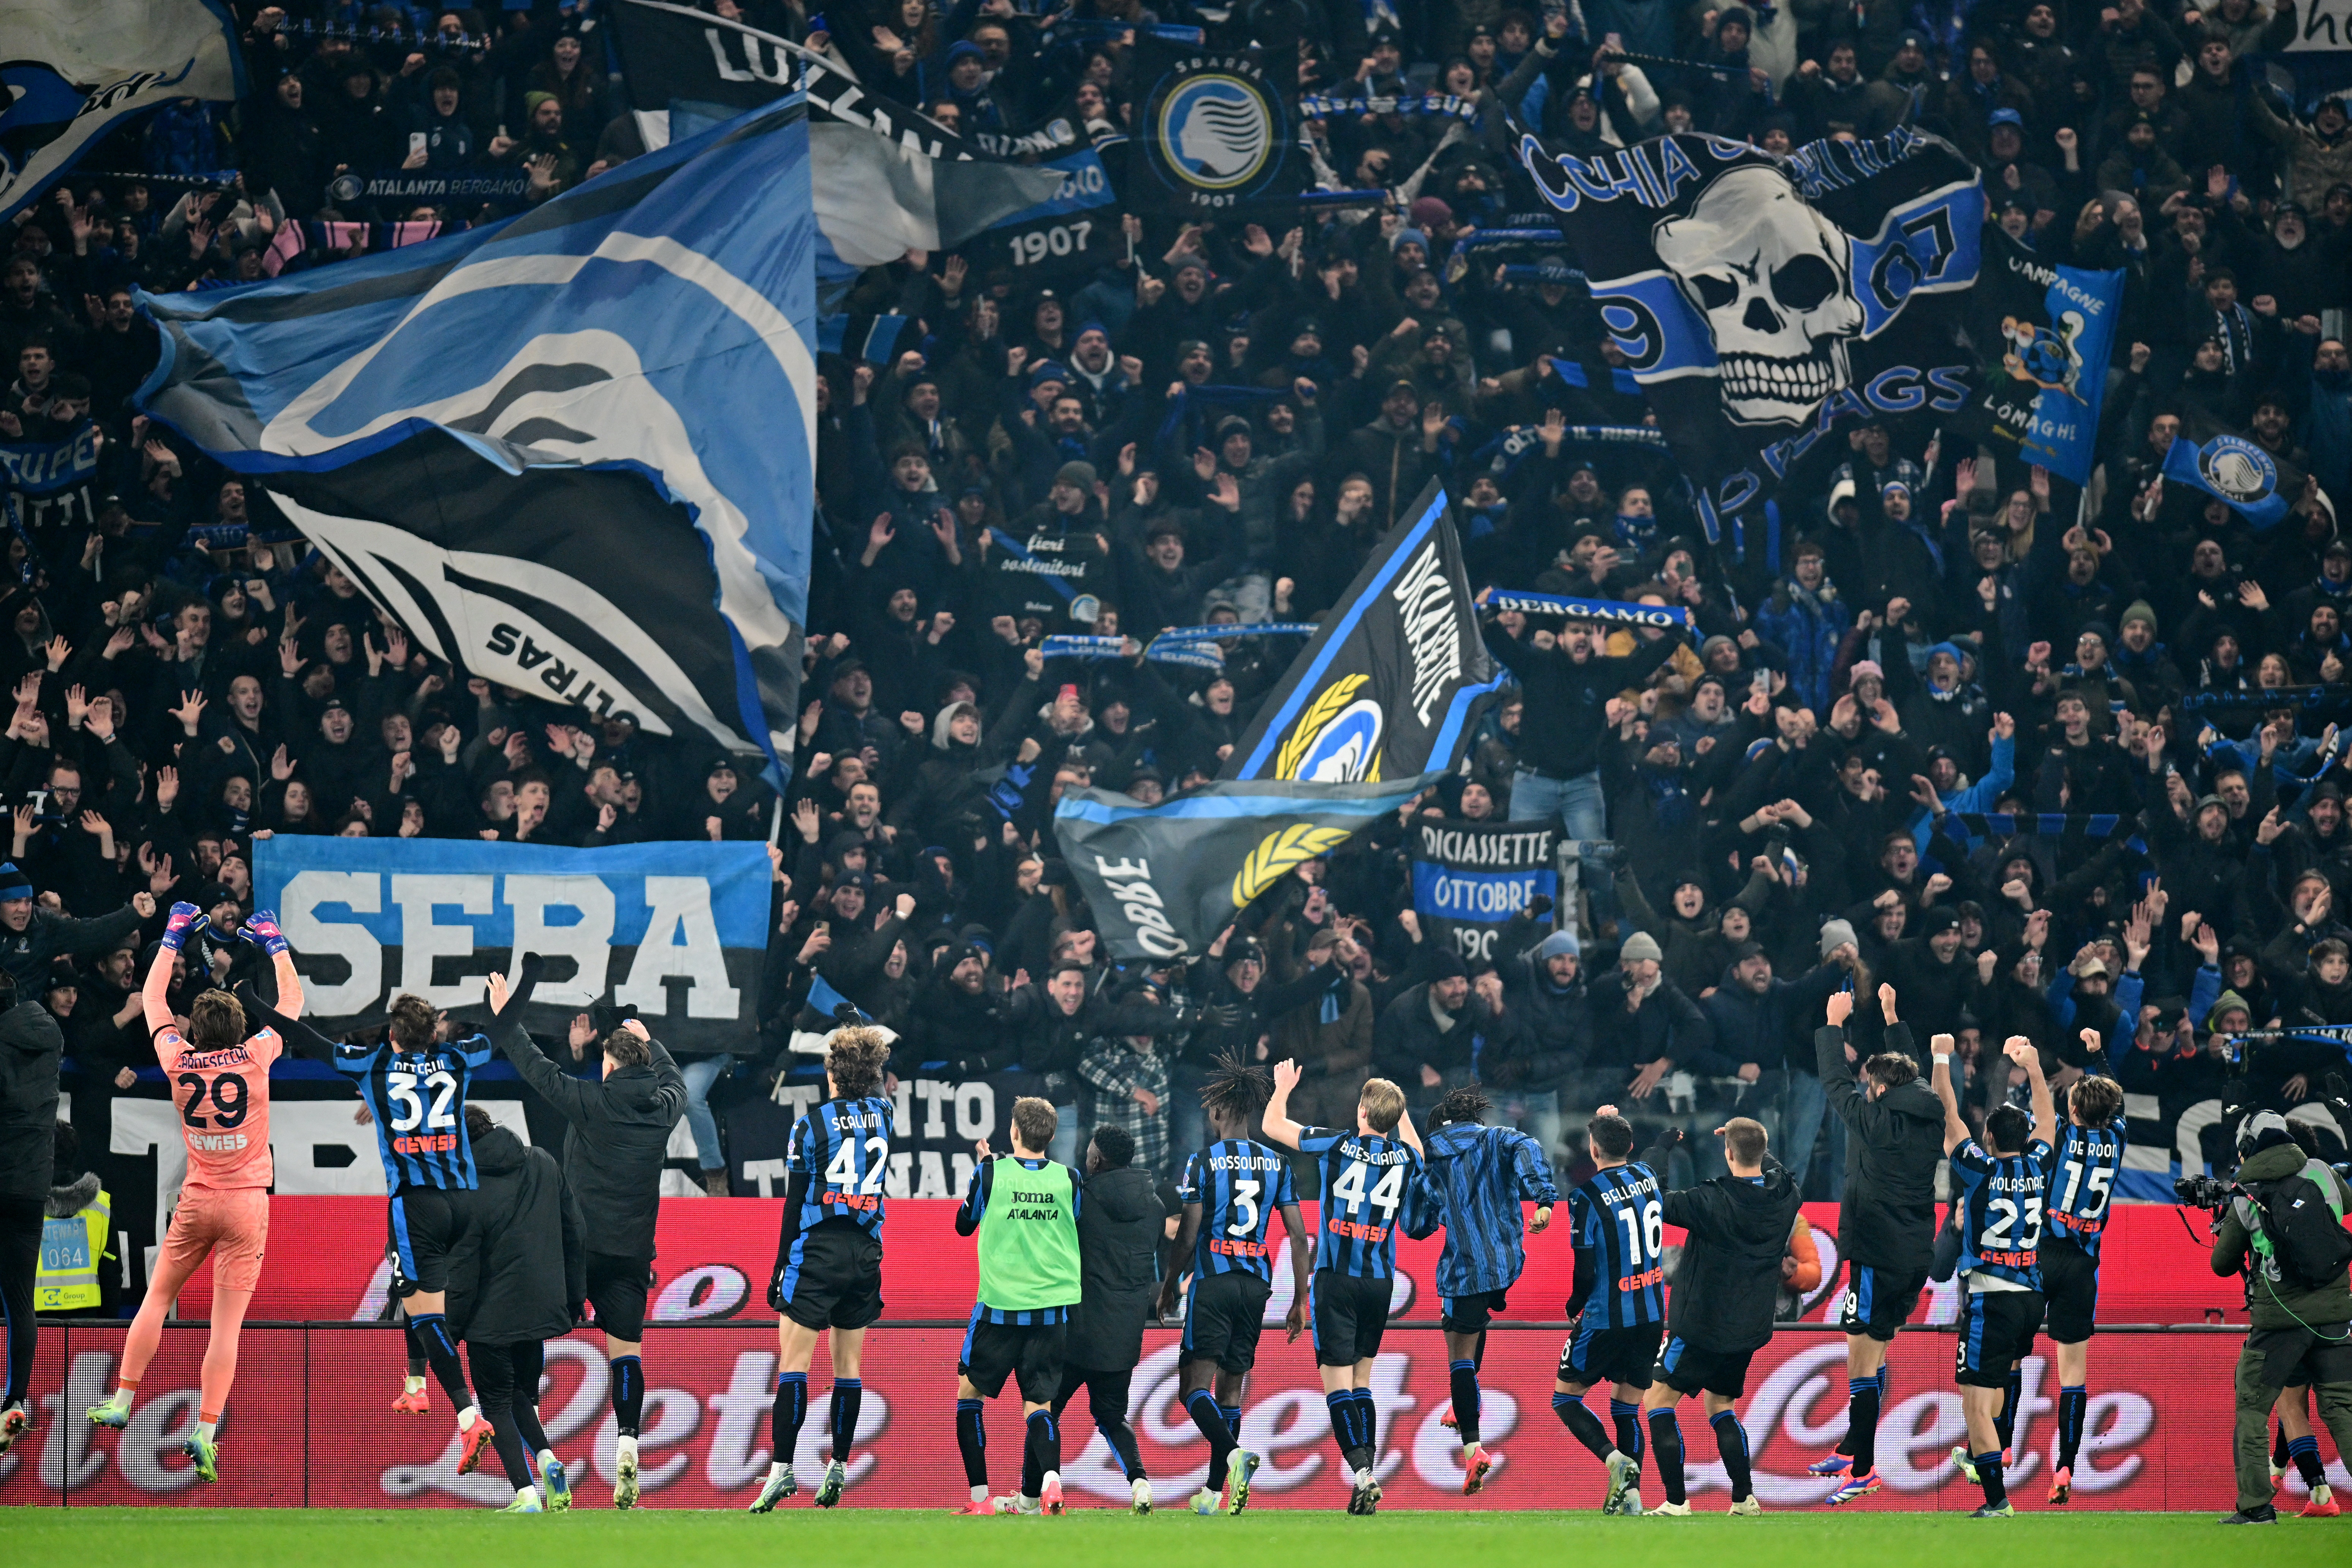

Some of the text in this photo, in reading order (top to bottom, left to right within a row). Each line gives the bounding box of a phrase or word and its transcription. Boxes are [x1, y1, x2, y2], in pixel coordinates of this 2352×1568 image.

[366, 179, 526, 195] ATALANTA BERGAMO
[1009, 220, 1092, 266] 1907
[2029, 394, 2044, 409] &
[1503, 428, 1537, 455] OLT
[1421, 825, 1552, 865] DICIASSETTE
[280, 870, 741, 1022] SEBA
[177, 1072, 248, 1129] 29
[388, 1070, 457, 1132] 32
[778, 1079, 996, 1140] TNTO
[831, 1113, 883, 1132] SCALVINI
[824, 1136, 889, 1196] 42
[1209, 1155, 1282, 1172] KOSSOUNOU
[2068, 1139, 2118, 1158] DE ROON
[1010, 1191, 1055, 1204] Joma
[1227, 1179, 1260, 1237] 3
[1332, 1159, 1404, 1220] 44
[1600, 1176, 1659, 1206] BELLANOVA
[2060, 1160, 2115, 1219] 15
[1006, 1208, 1059, 1220] ATALANTA
[1618, 1200, 1663, 1265] 16
[1980, 1197, 2043, 1250] 23
[49, 1247, 83, 1267] 064
